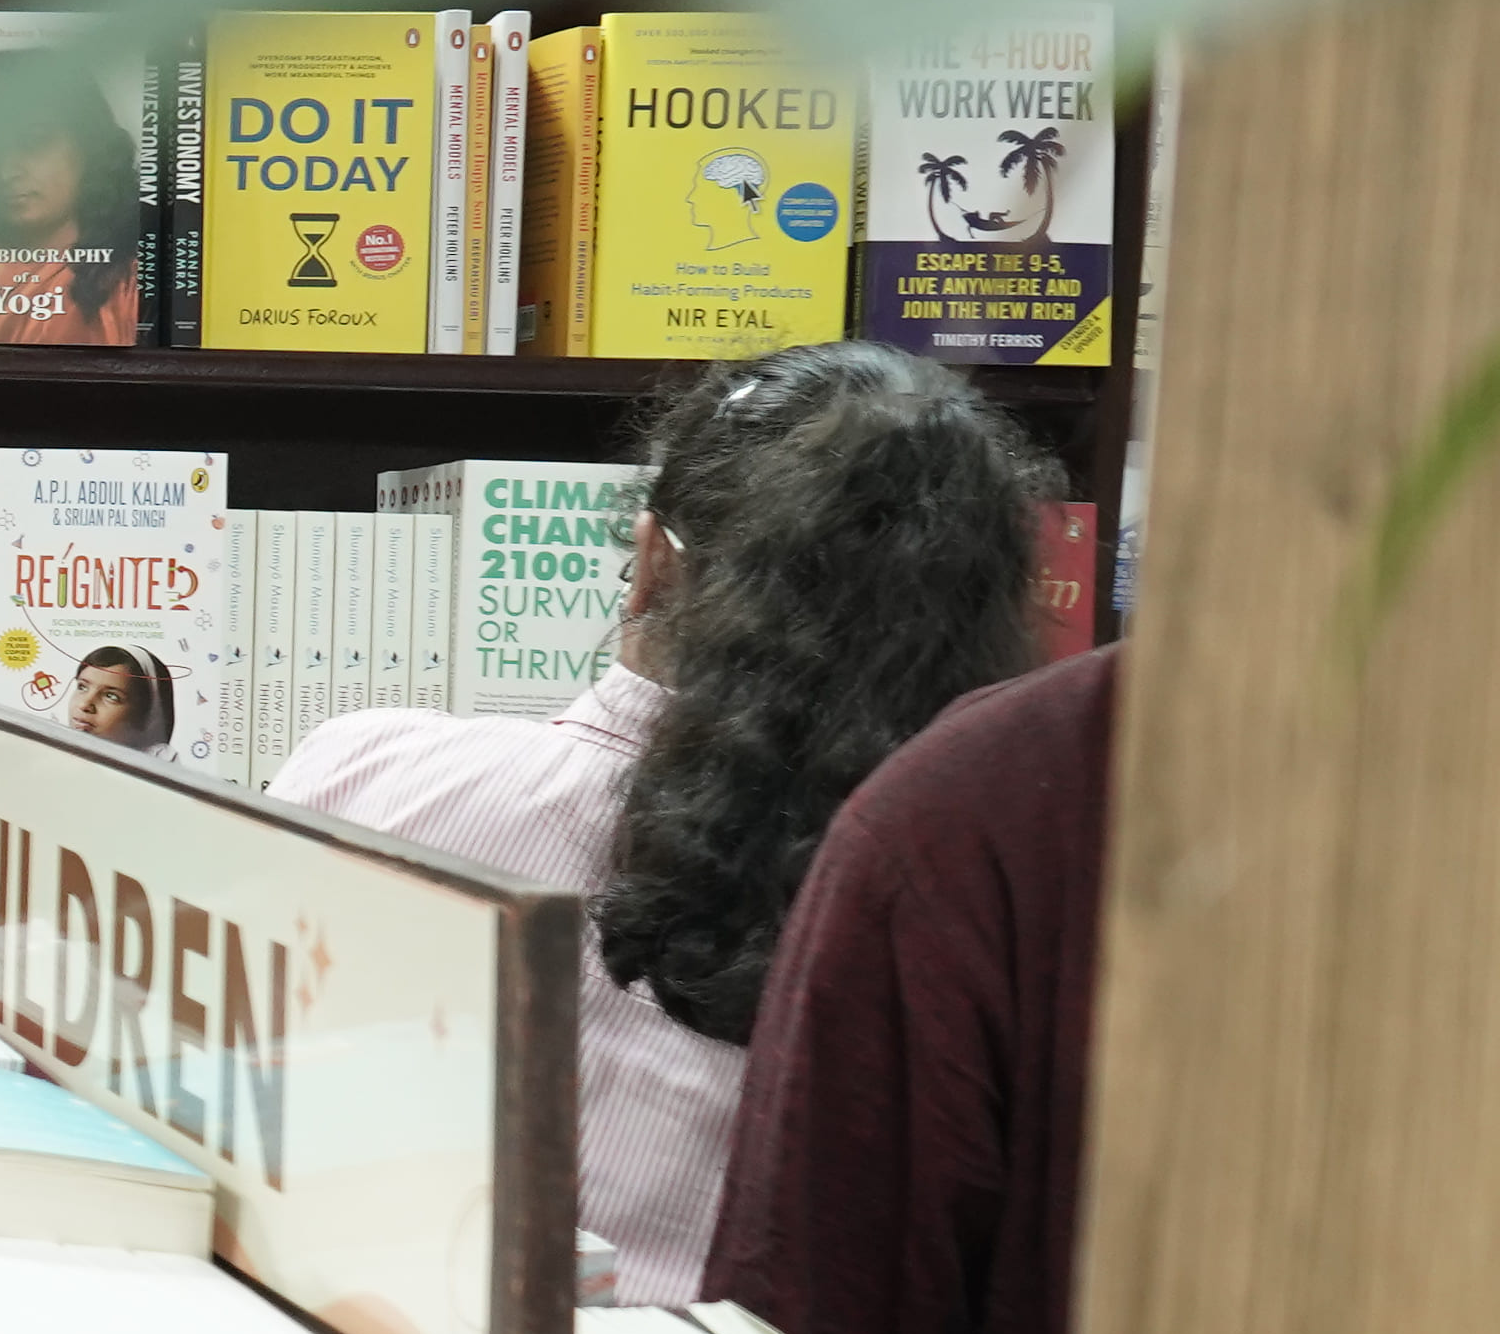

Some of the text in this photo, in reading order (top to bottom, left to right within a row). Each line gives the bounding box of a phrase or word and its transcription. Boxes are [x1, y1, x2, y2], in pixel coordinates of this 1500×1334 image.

[229, 99, 413, 146] DO IT
[627, 86, 838, 132] HOOKED
[227, 155, 409, 194] TODAY
[667, 307, 775, 331] NIR EYAL
[481, 549, 600, 582] 2100:
[477, 619, 520, 644] OR
